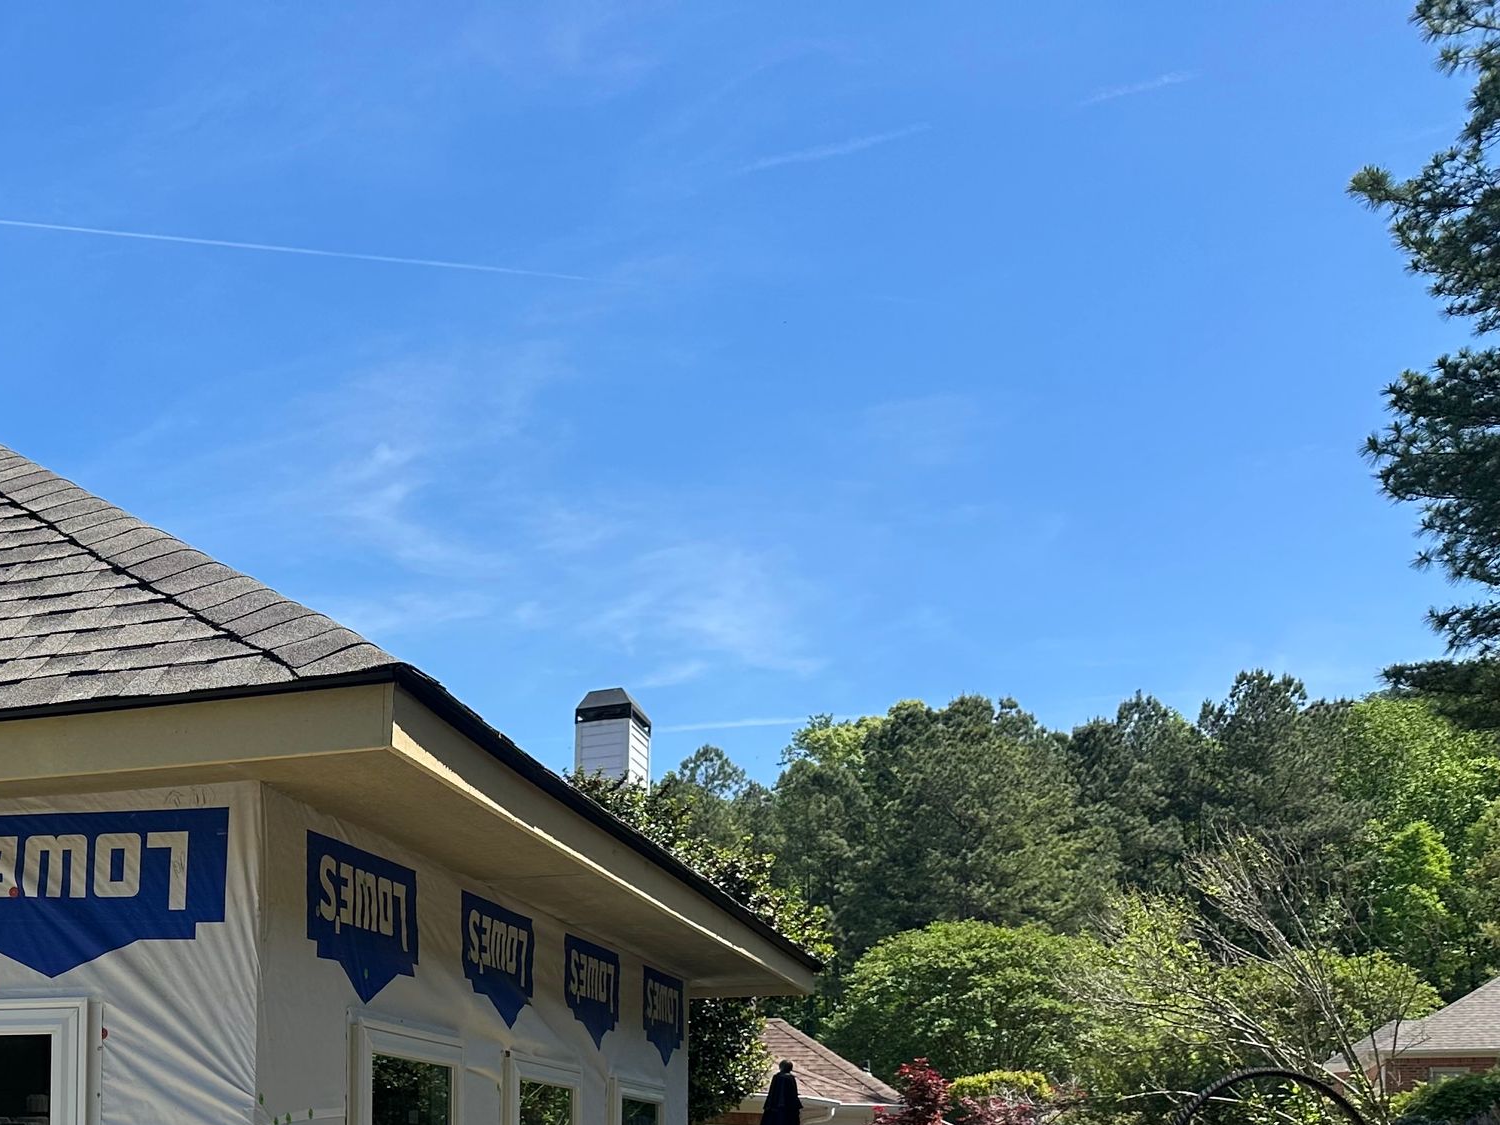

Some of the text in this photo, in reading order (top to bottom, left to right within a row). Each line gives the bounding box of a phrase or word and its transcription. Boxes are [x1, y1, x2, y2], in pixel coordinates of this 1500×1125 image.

[320, 854, 408, 953] LOWE'S
[469, 909, 528, 988] LOWE'S
[570, 948, 616, 1014] LOWE'S
